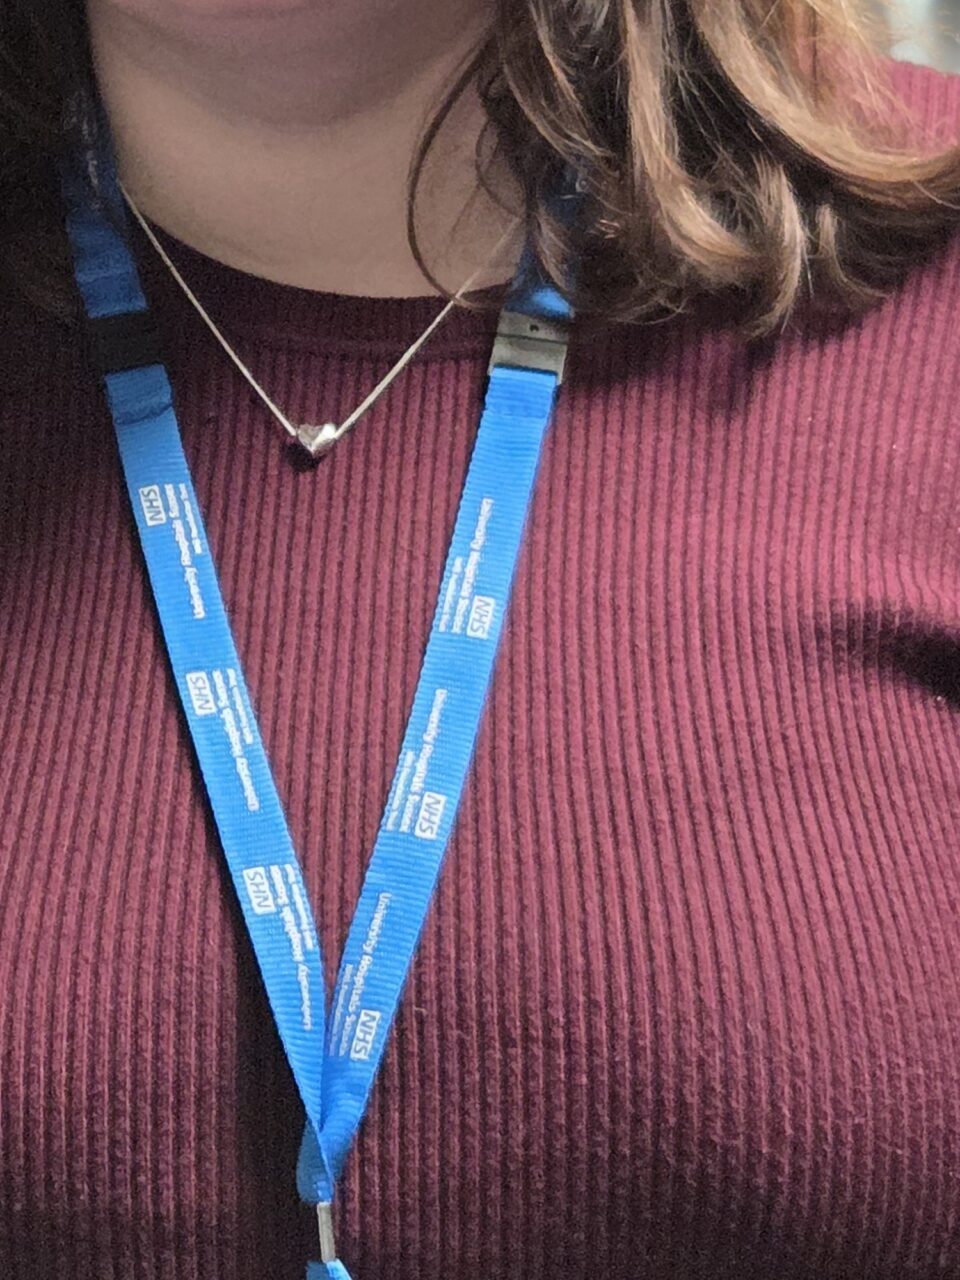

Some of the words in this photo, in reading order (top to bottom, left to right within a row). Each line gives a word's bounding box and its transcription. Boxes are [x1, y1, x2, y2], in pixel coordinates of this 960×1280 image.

[141, 487, 164, 524] NHS
[469, 596, 494, 637] NHS
[188, 674, 215, 713] NHS
[417, 793, 444, 837] NHS
[245, 869, 273, 911] NHS
[352, 1010, 378, 1058] NHS
